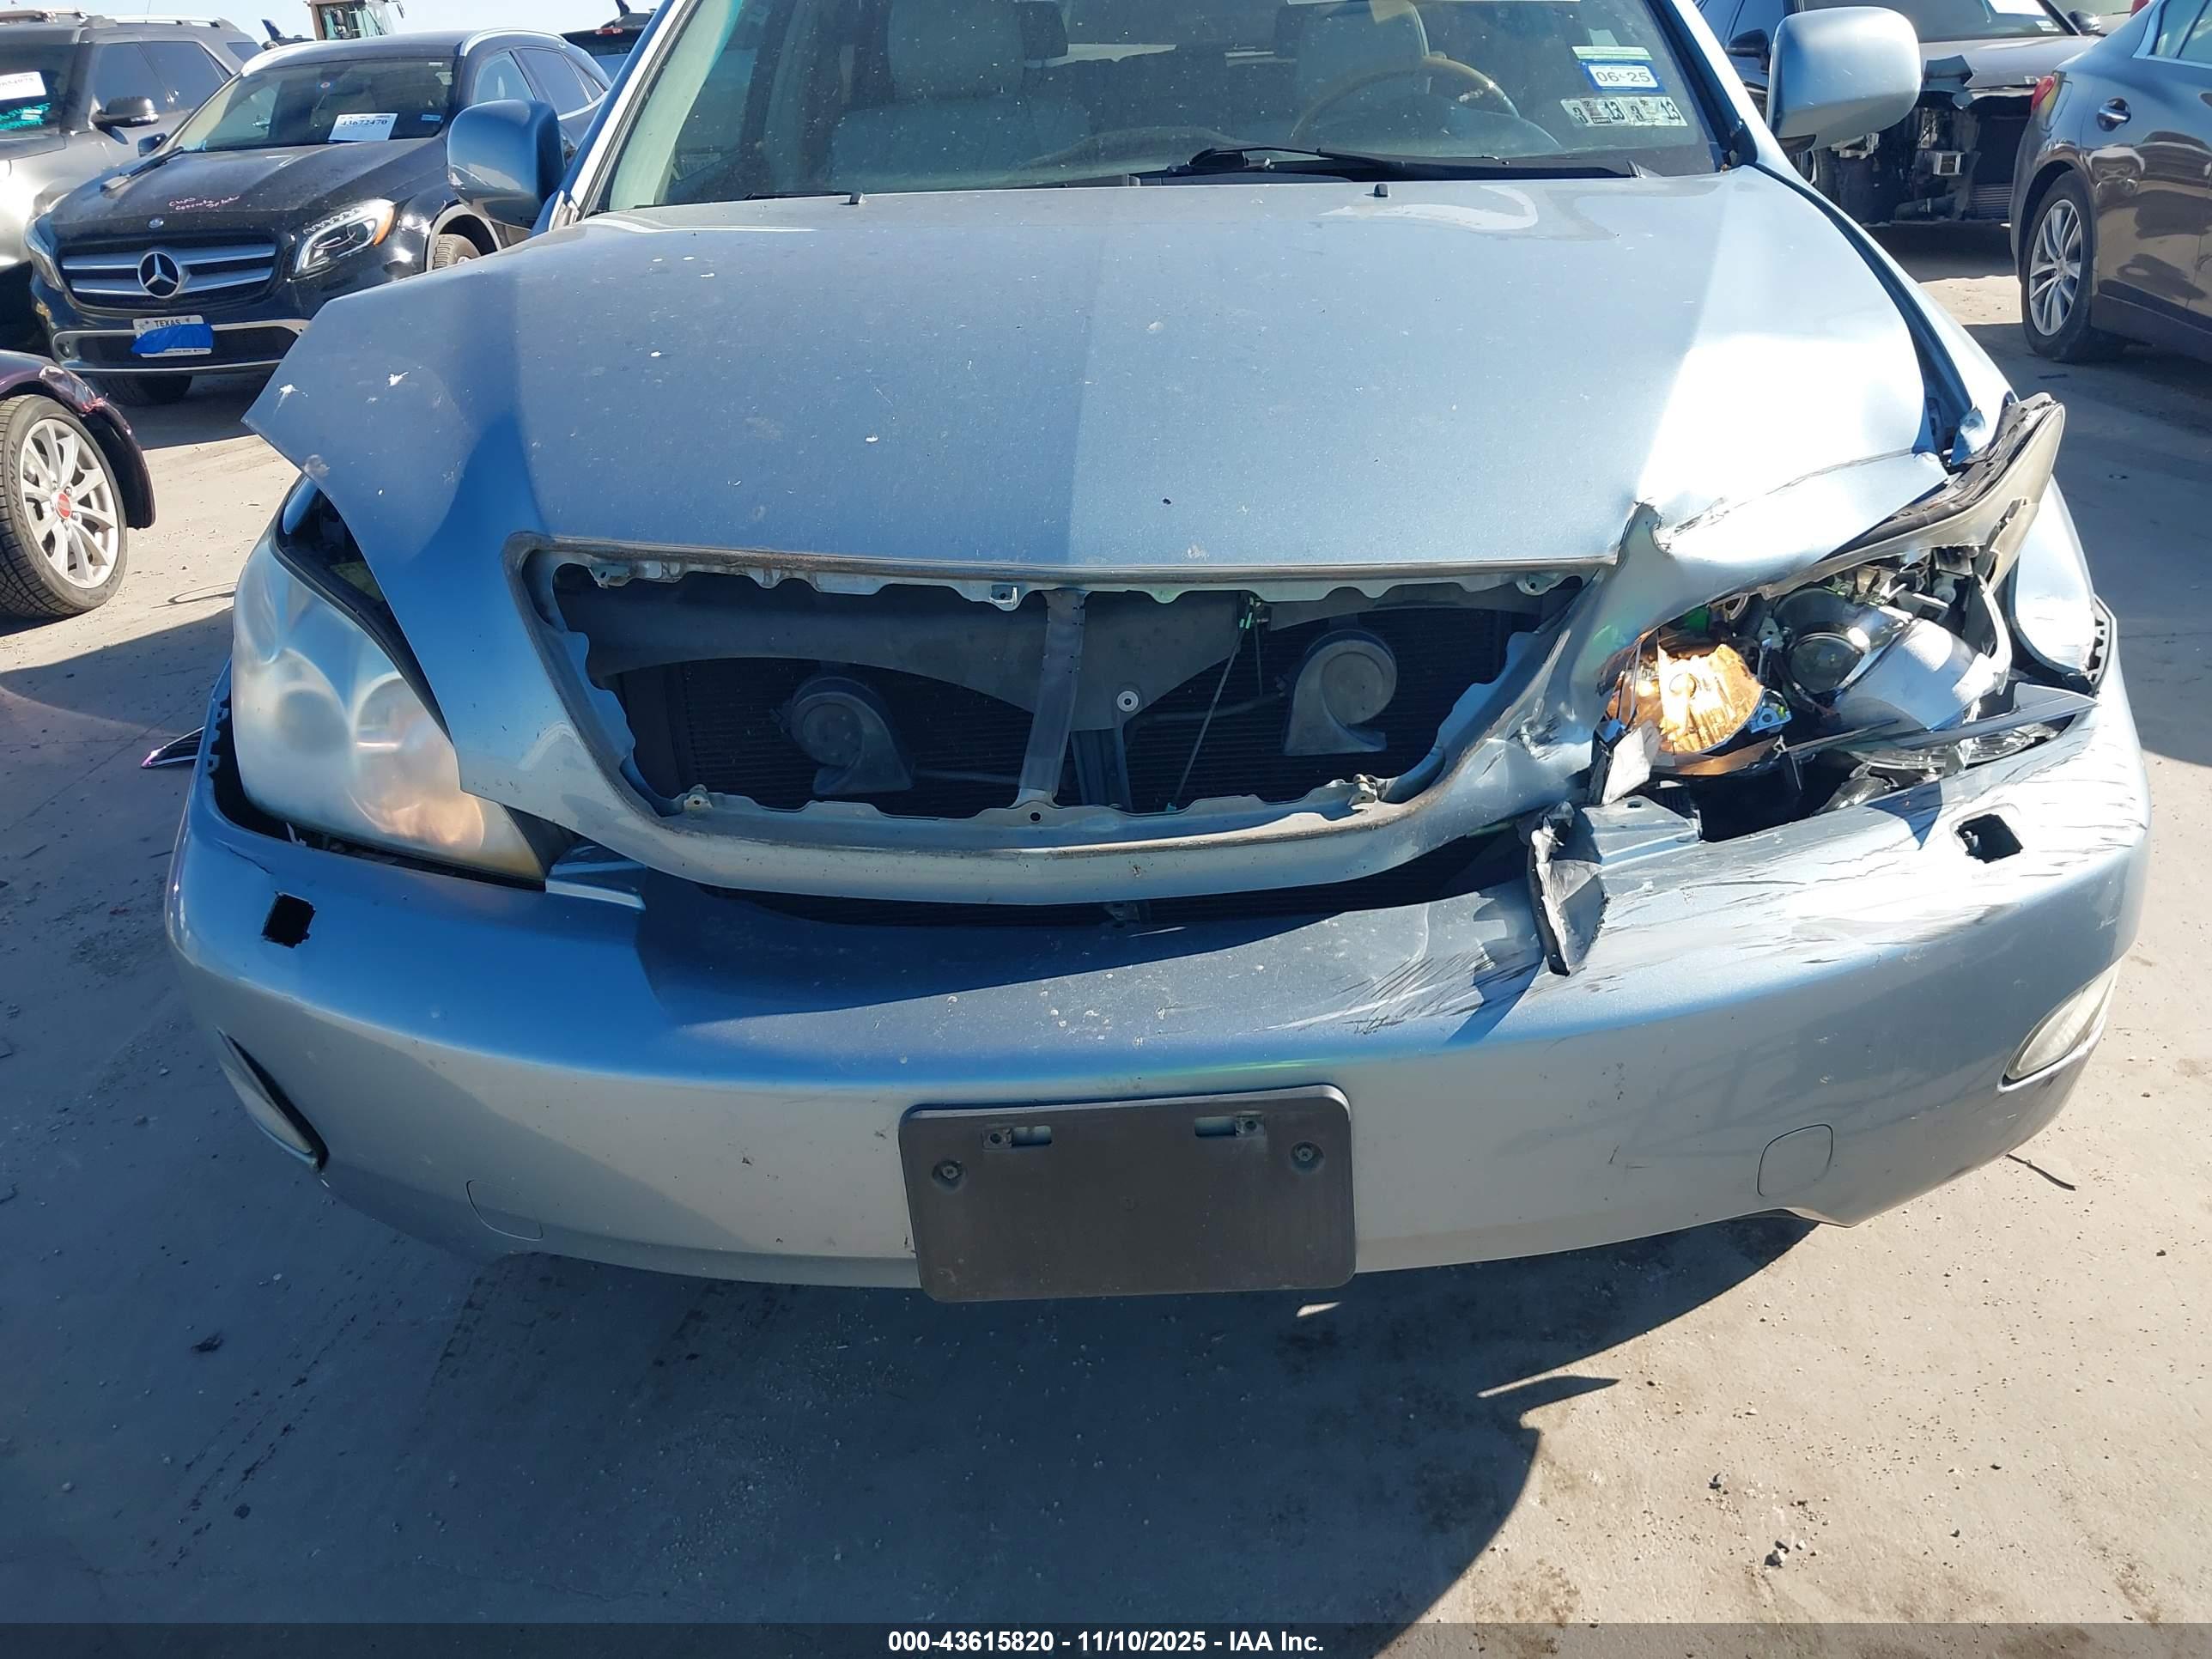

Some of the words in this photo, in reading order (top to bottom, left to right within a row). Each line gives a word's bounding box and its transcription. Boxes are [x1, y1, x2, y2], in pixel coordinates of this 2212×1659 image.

[1595, 71, 1620, 82] 06
[1626, 71, 1650, 82] 25
[1572, 106, 1589, 124] 3
[1604, 100, 1626, 120] 13
[1630, 105, 1644, 121] 3
[1660, 100, 1681, 120] 13
[154, 319, 181, 328] TEXAS
